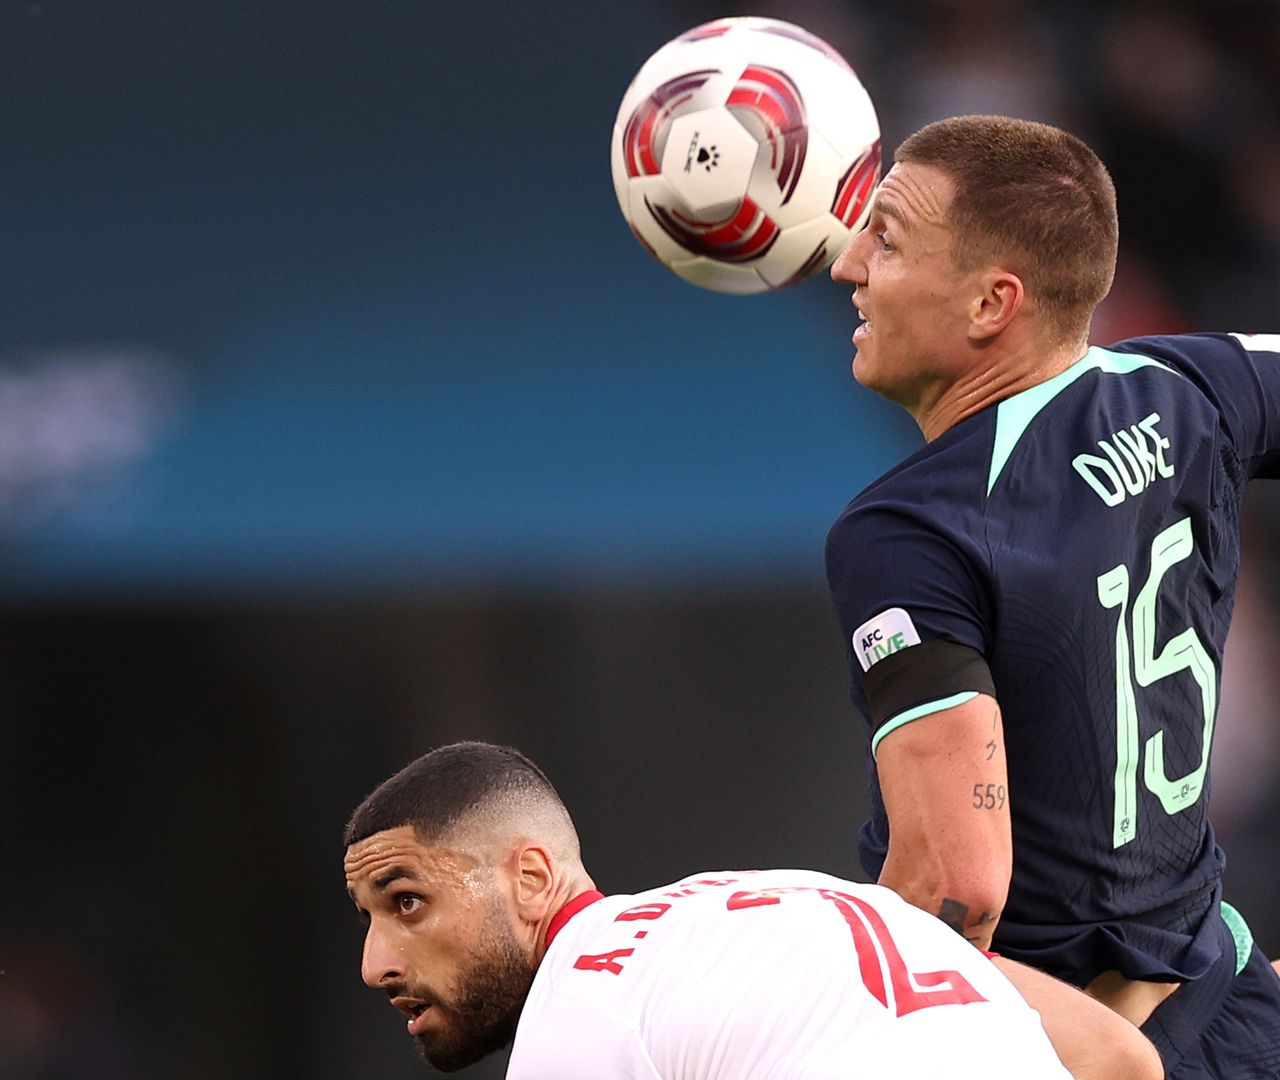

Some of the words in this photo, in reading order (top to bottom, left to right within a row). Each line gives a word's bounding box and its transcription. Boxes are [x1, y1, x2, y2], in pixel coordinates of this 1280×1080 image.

[1072, 412, 1174, 507] DUKE
[861, 629, 883, 652] AFC
[1097, 517, 1217, 849] 15
[973, 783, 1006, 809] 559
